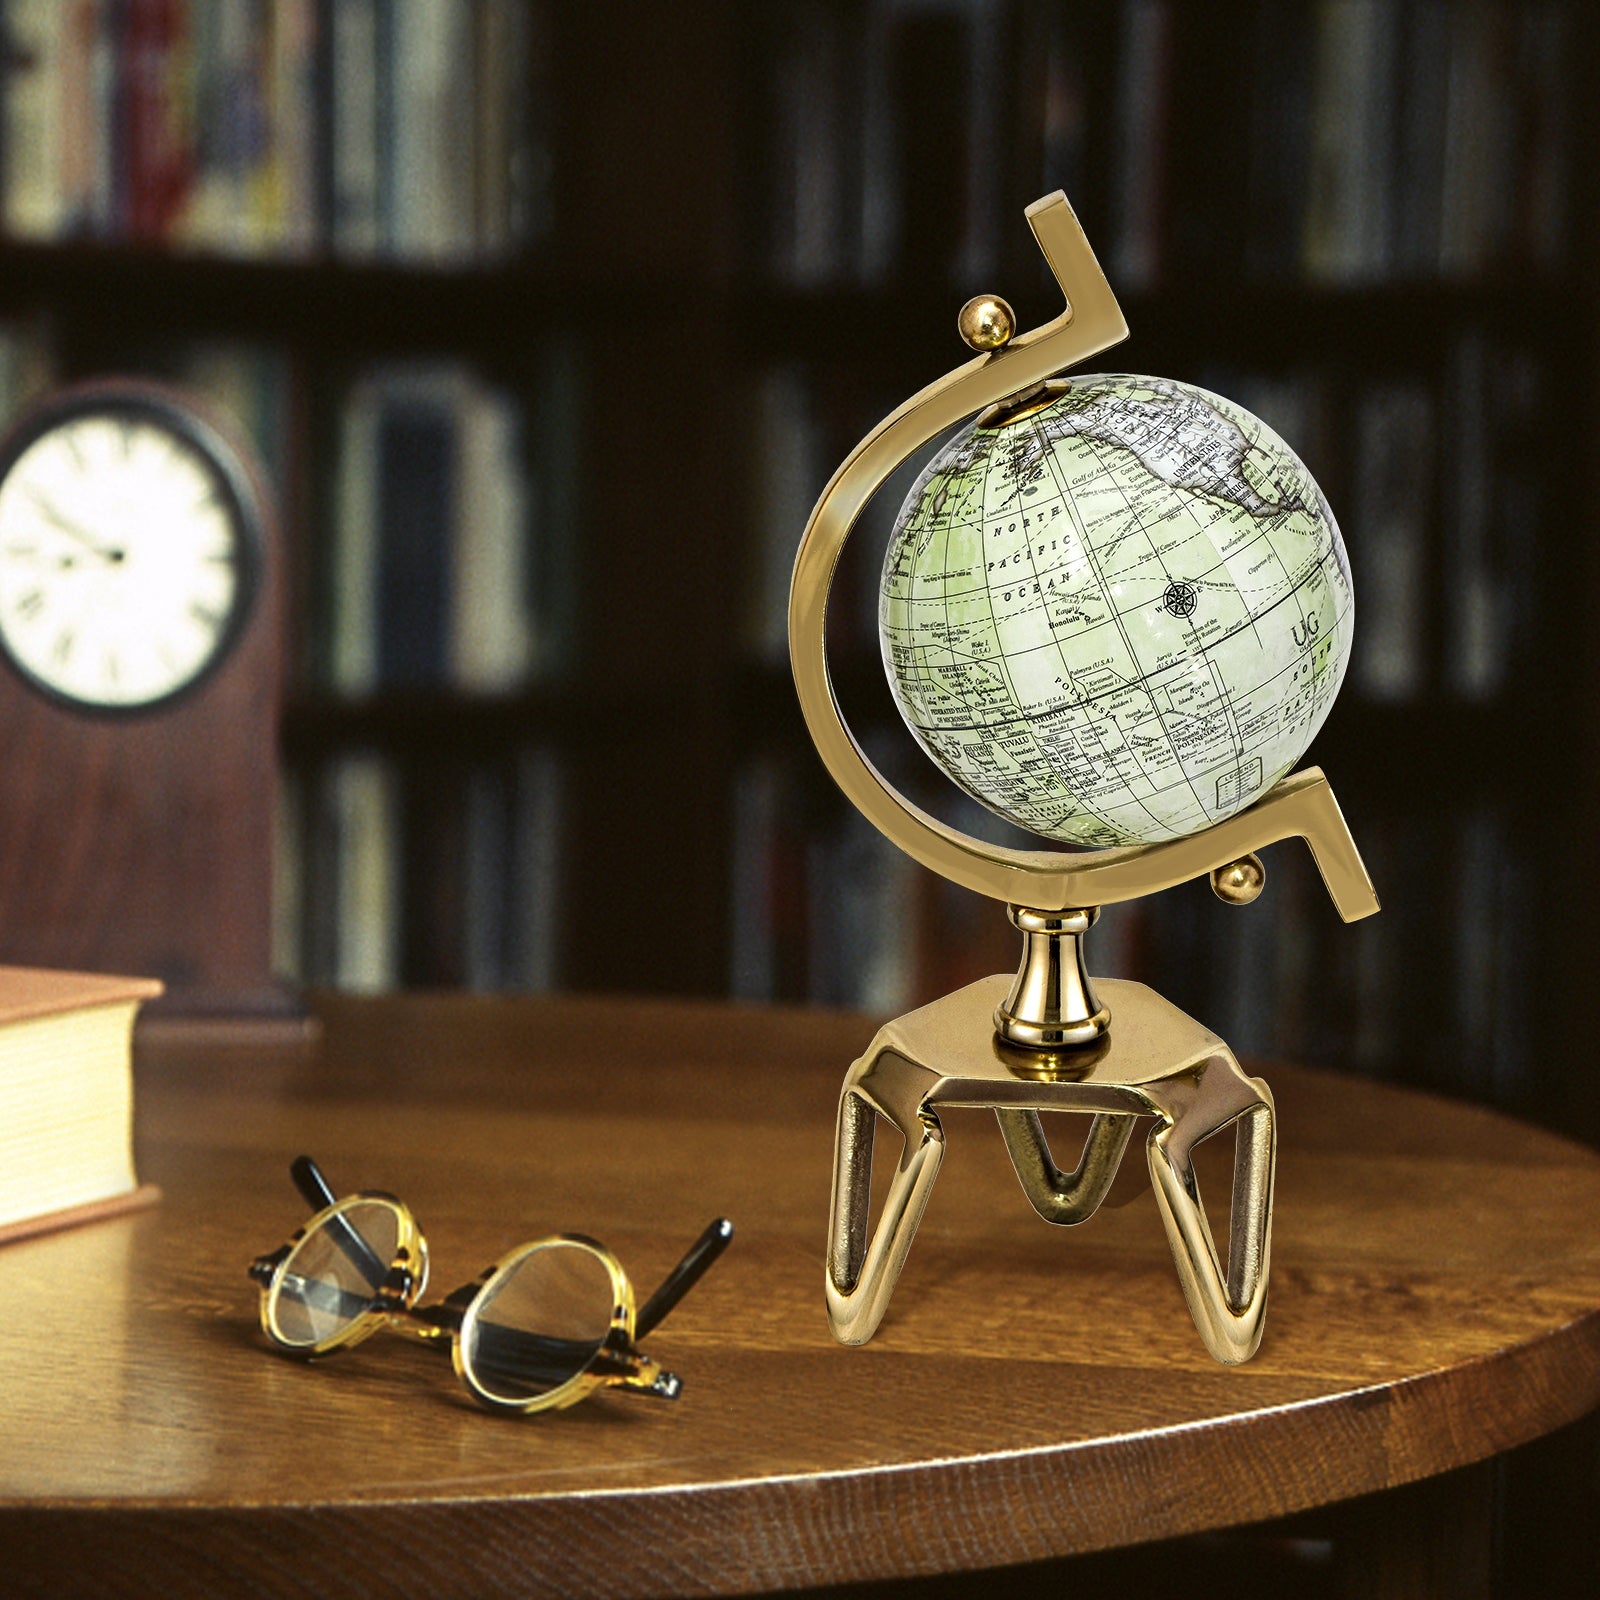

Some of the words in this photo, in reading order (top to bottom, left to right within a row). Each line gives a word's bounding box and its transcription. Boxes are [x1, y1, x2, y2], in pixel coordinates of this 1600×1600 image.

[1173, 455, 1201, 479] UNITED
[1199, 441, 1222, 459] STATES
[1120, 466, 1134, 476] Coos
[1128, 472, 1147, 483] Eureka
[1071, 475, 1087, 485] Gulf
[1130, 494, 1142, 503] San
[1140, 484, 1166, 497] Francisco
[993, 506, 1063, 538] NORTH
[987, 536, 1071, 573] PACIFIC
[1138, 552, 1154, 562] Tropic
[1159, 541, 1178, 552] Cancer
[1004, 573, 1070, 602] OCEAN
[1048, 616, 1081, 630] Honolulu
[1181, 626, 1204, 641] Direction
[1201, 625, 1222, 639] Rotation
[1144, 749, 1171, 764] FRENCH
